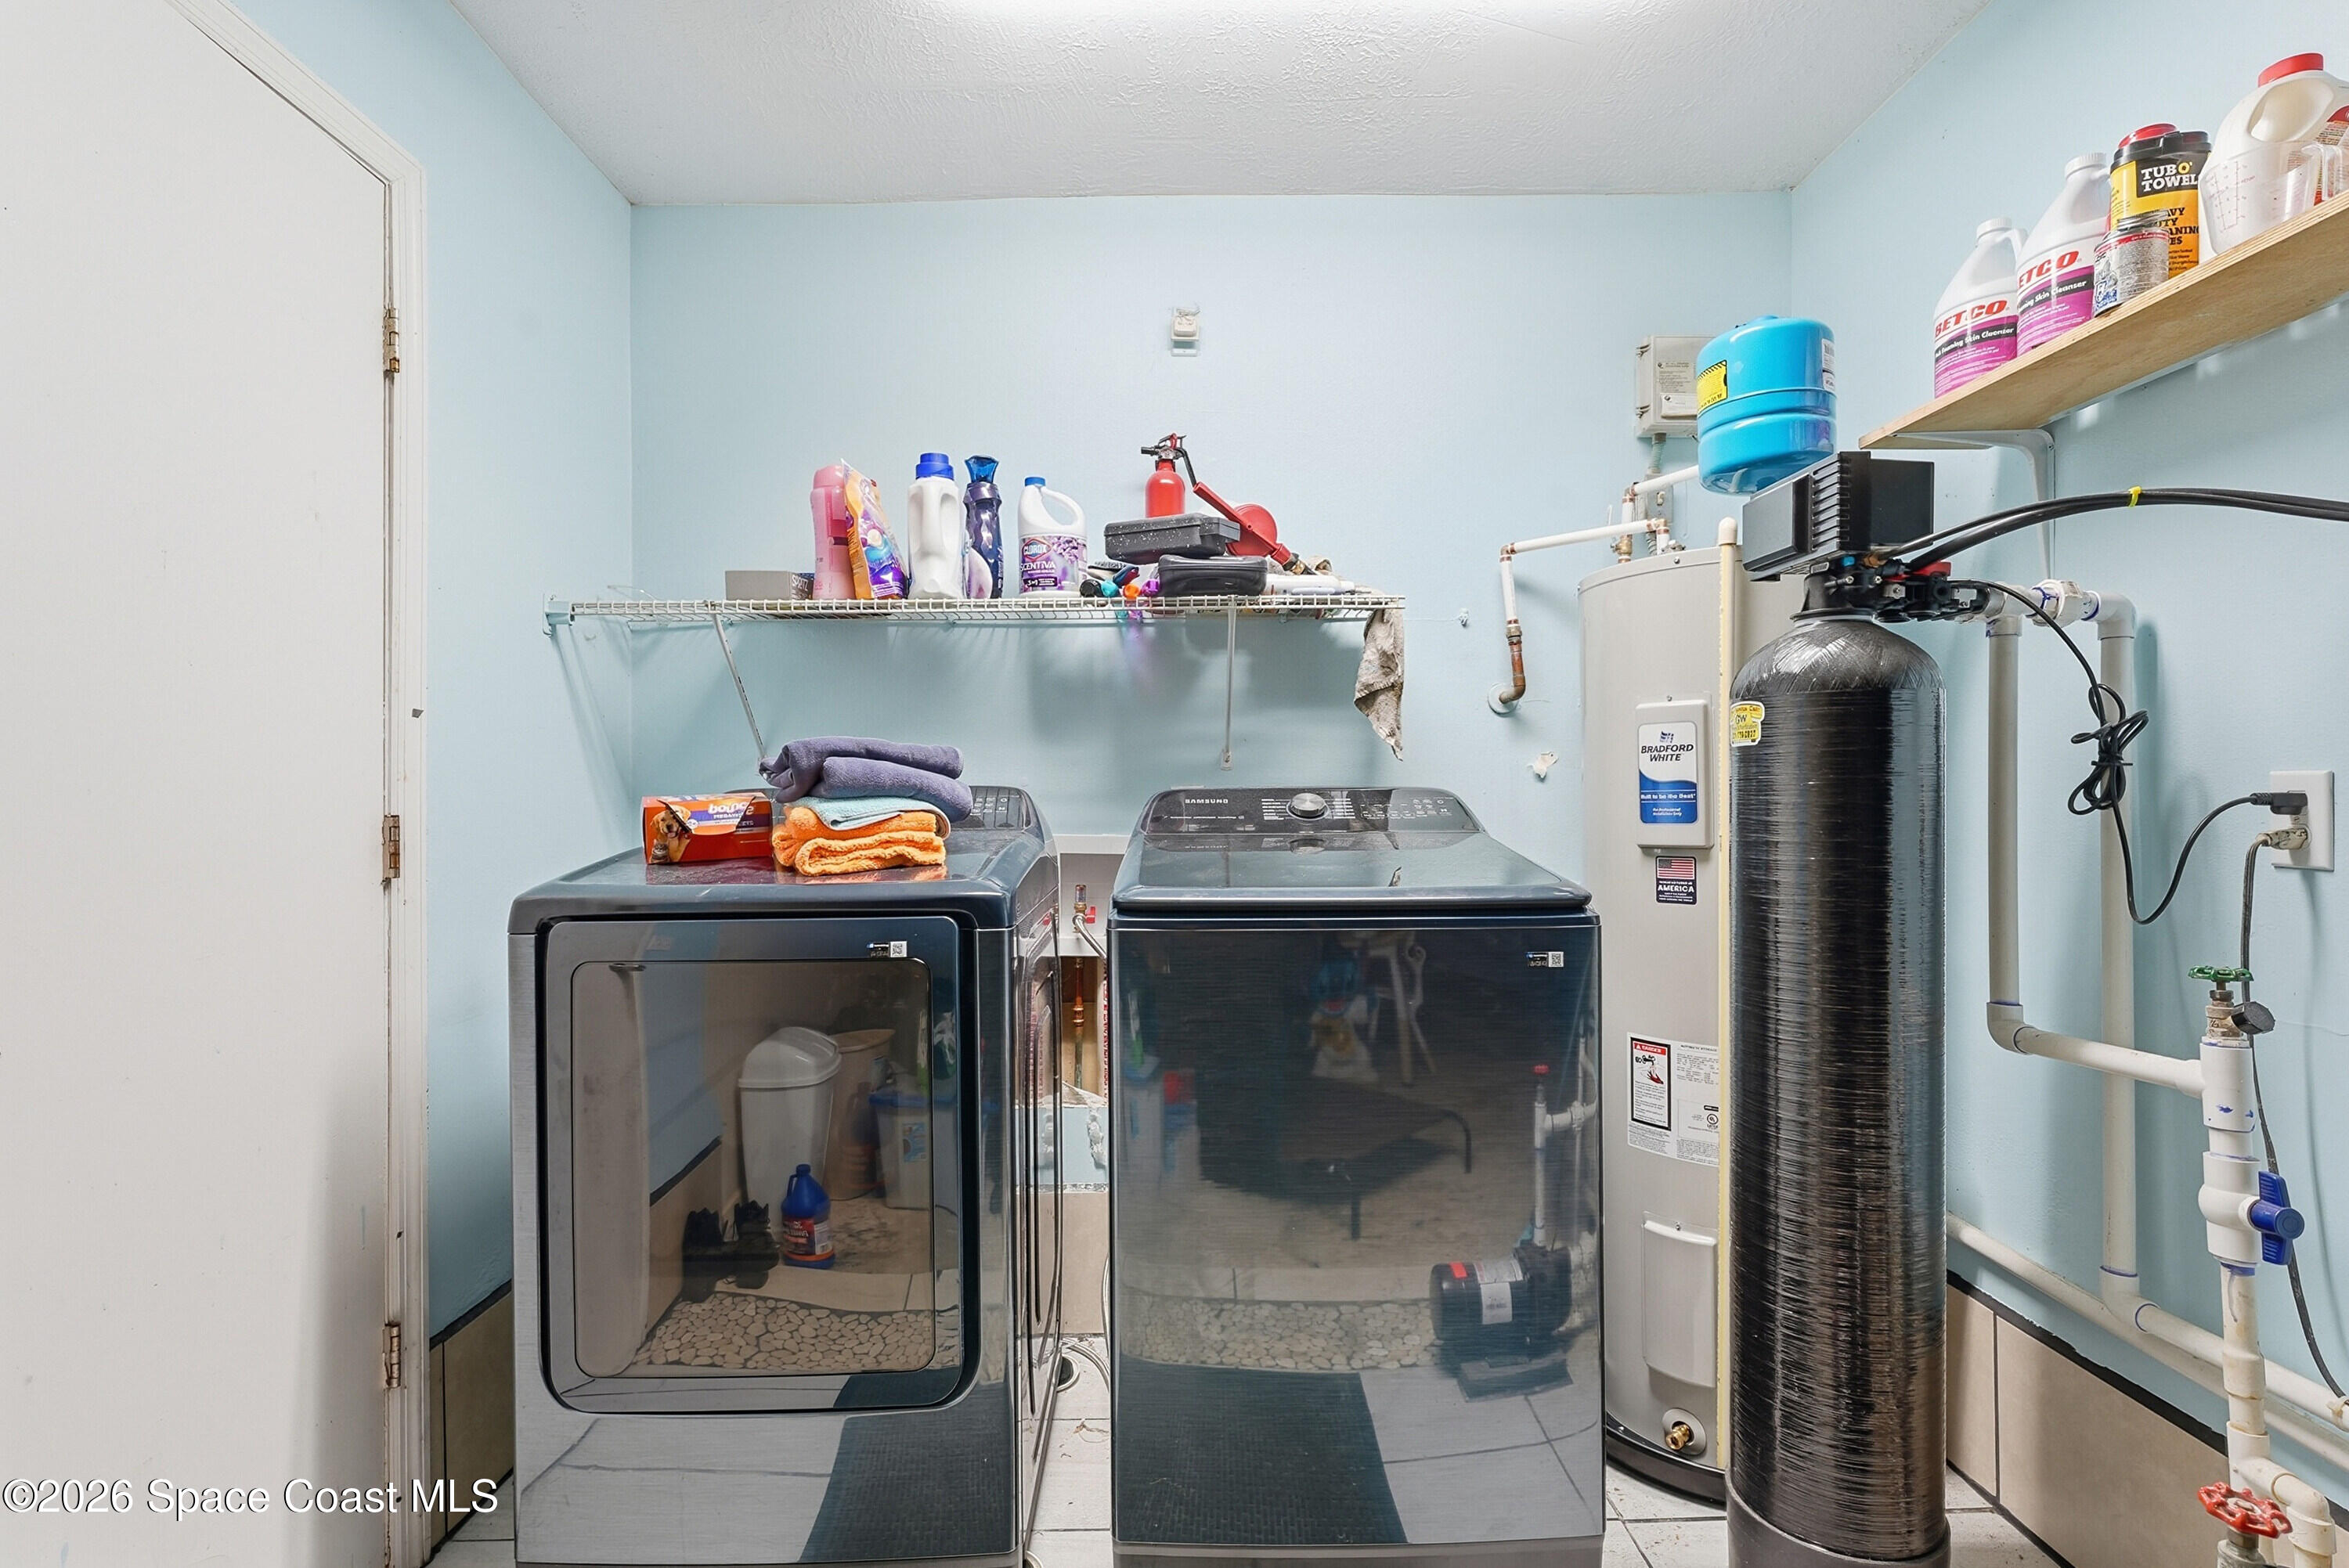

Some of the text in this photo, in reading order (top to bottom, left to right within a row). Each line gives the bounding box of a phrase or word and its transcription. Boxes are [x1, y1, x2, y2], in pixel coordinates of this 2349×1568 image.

[2141, 164, 2177, 180] TUB
[2141, 174, 2198, 192] TOWEL
[2019, 251, 2079, 288] ETCO
[2035, 291, 2050, 301] Skin
[2051, 281, 2087, 296] Cleanser
[1936, 300, 2007, 338] BETCO
[1640, 744, 1694, 754] BRADFORD
[1650, 753, 1682, 762] WHITE
[1657, 885, 1695, 893] AMERICA
